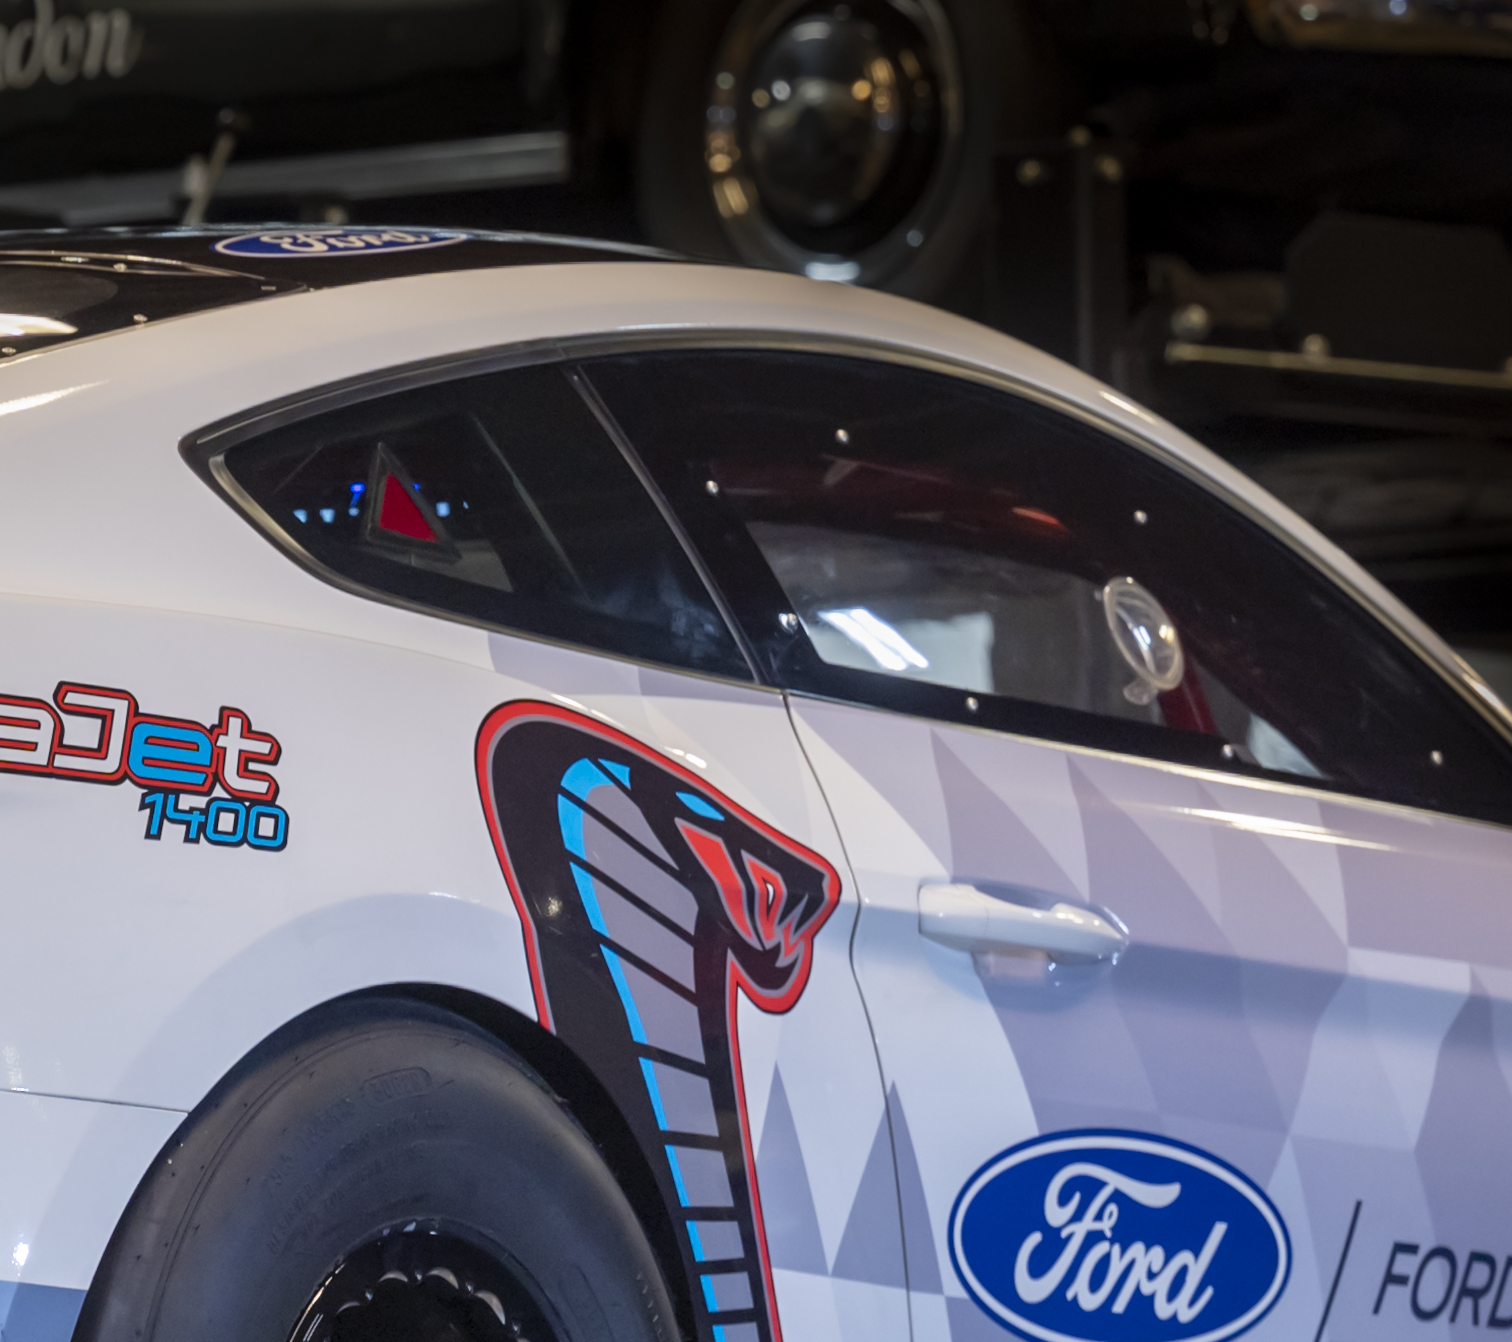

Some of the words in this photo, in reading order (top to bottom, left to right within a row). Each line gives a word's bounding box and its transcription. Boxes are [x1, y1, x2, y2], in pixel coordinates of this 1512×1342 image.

[260, 228, 431, 254] Ford
[139, 790, 289, 852] 1400
[1013, 1161, 1228, 1324] Ford
